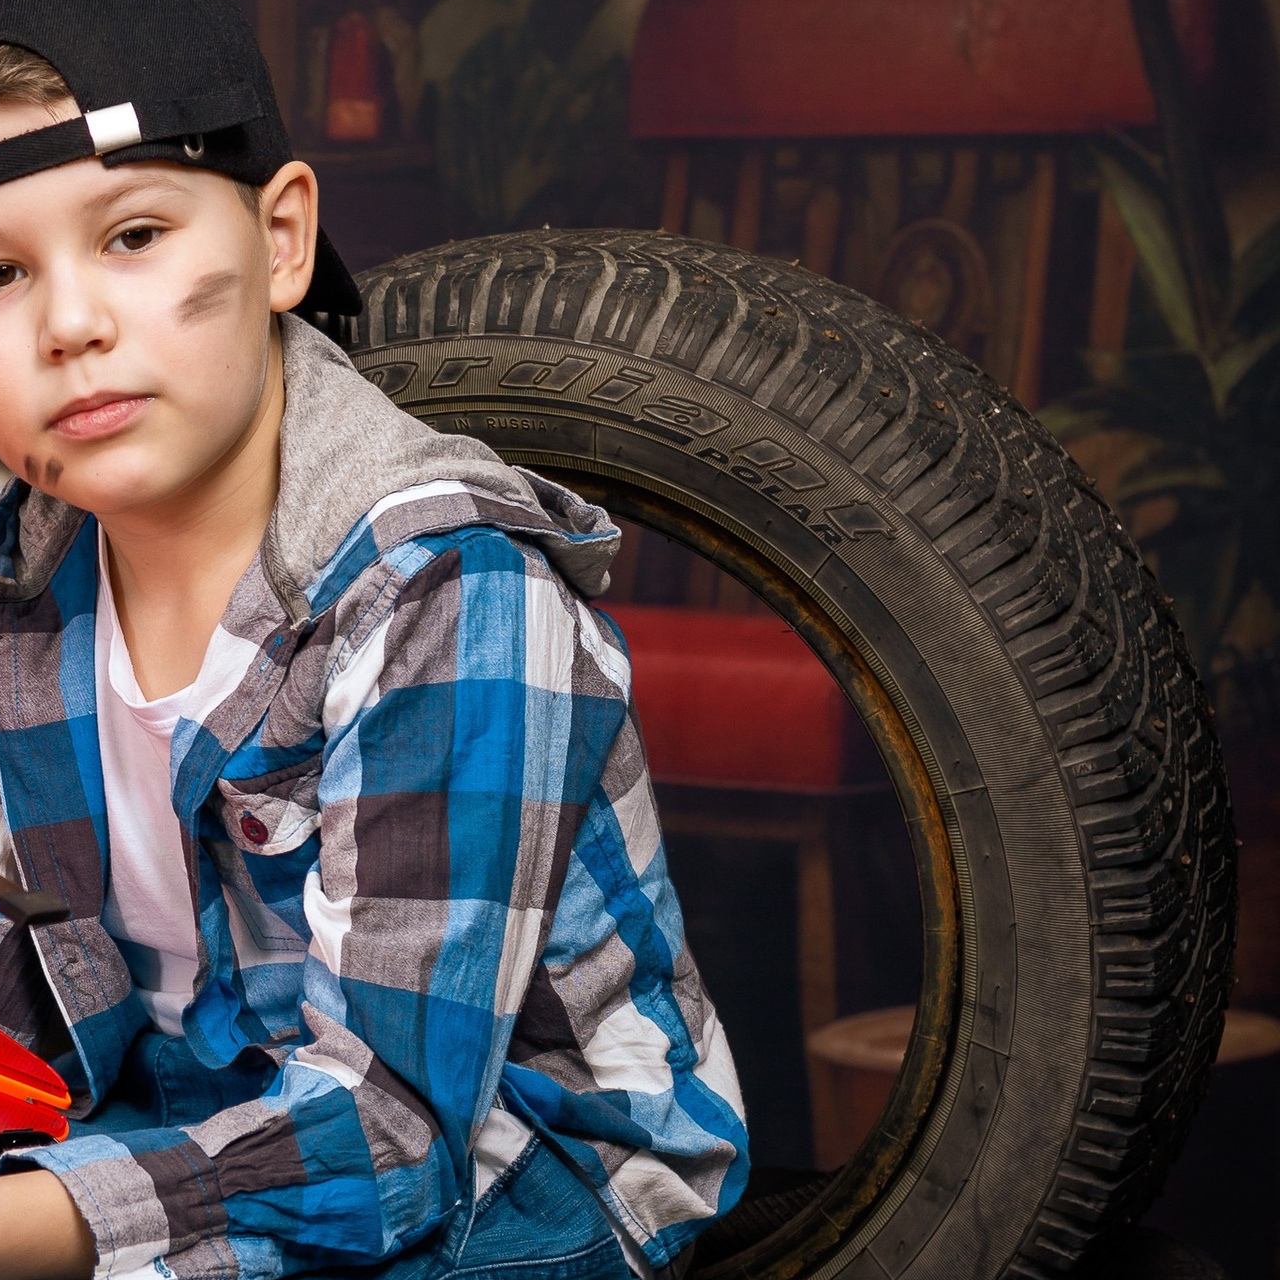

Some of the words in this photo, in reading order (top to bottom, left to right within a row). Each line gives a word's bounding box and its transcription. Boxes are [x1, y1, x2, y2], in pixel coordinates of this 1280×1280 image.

[358, 354, 897, 542] ordiant
[453, 418, 471, 431] IN
[485, 416, 548, 432] RUSSIA
[696, 447, 844, 546] POLAR
